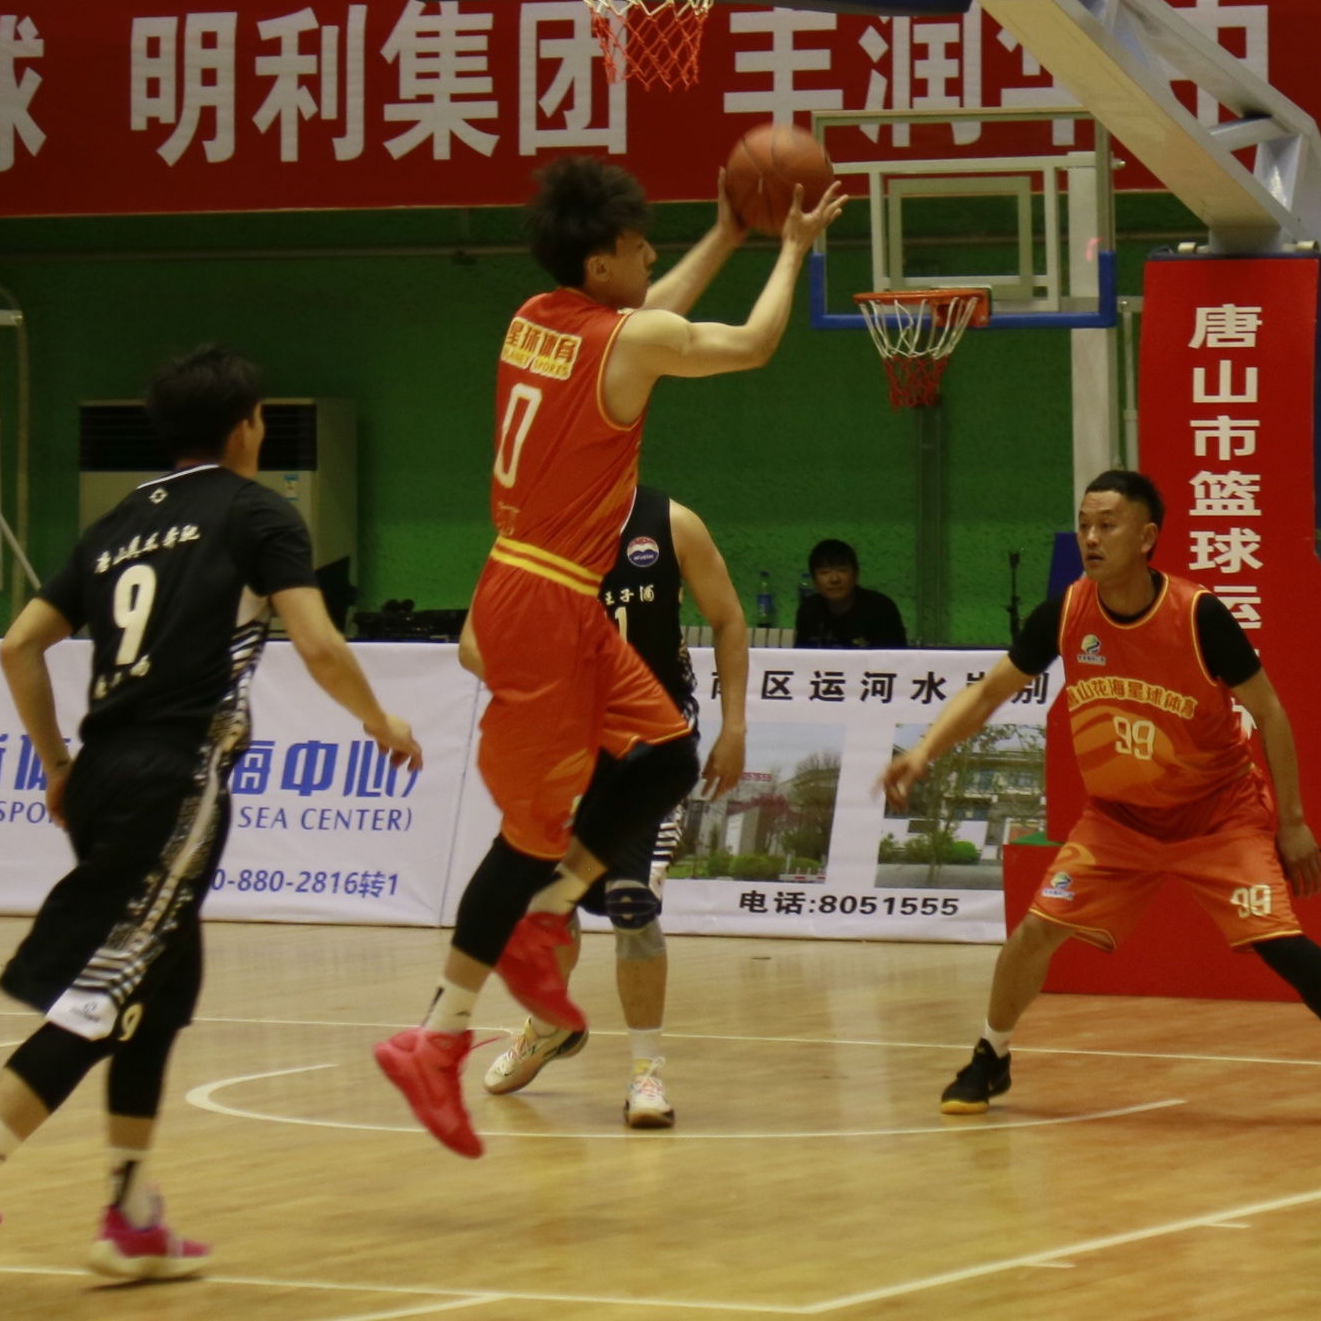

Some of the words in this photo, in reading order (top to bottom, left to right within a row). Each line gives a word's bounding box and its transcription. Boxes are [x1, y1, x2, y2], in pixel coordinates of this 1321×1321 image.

[494, 383, 542, 488] 0
[1188, 303, 1263, 740] 唐山市篮球运
[113, 564, 157, 666] 9
[711, 671, 1050, 706] 区运河水别
[1113, 716, 1155, 760] 99
[237, 806, 287, 829] SEA
[300, 807, 413, 831] CENTER)
[1230, 884, 1271, 919] 99
[119, 1003, 144, 1042] 9
